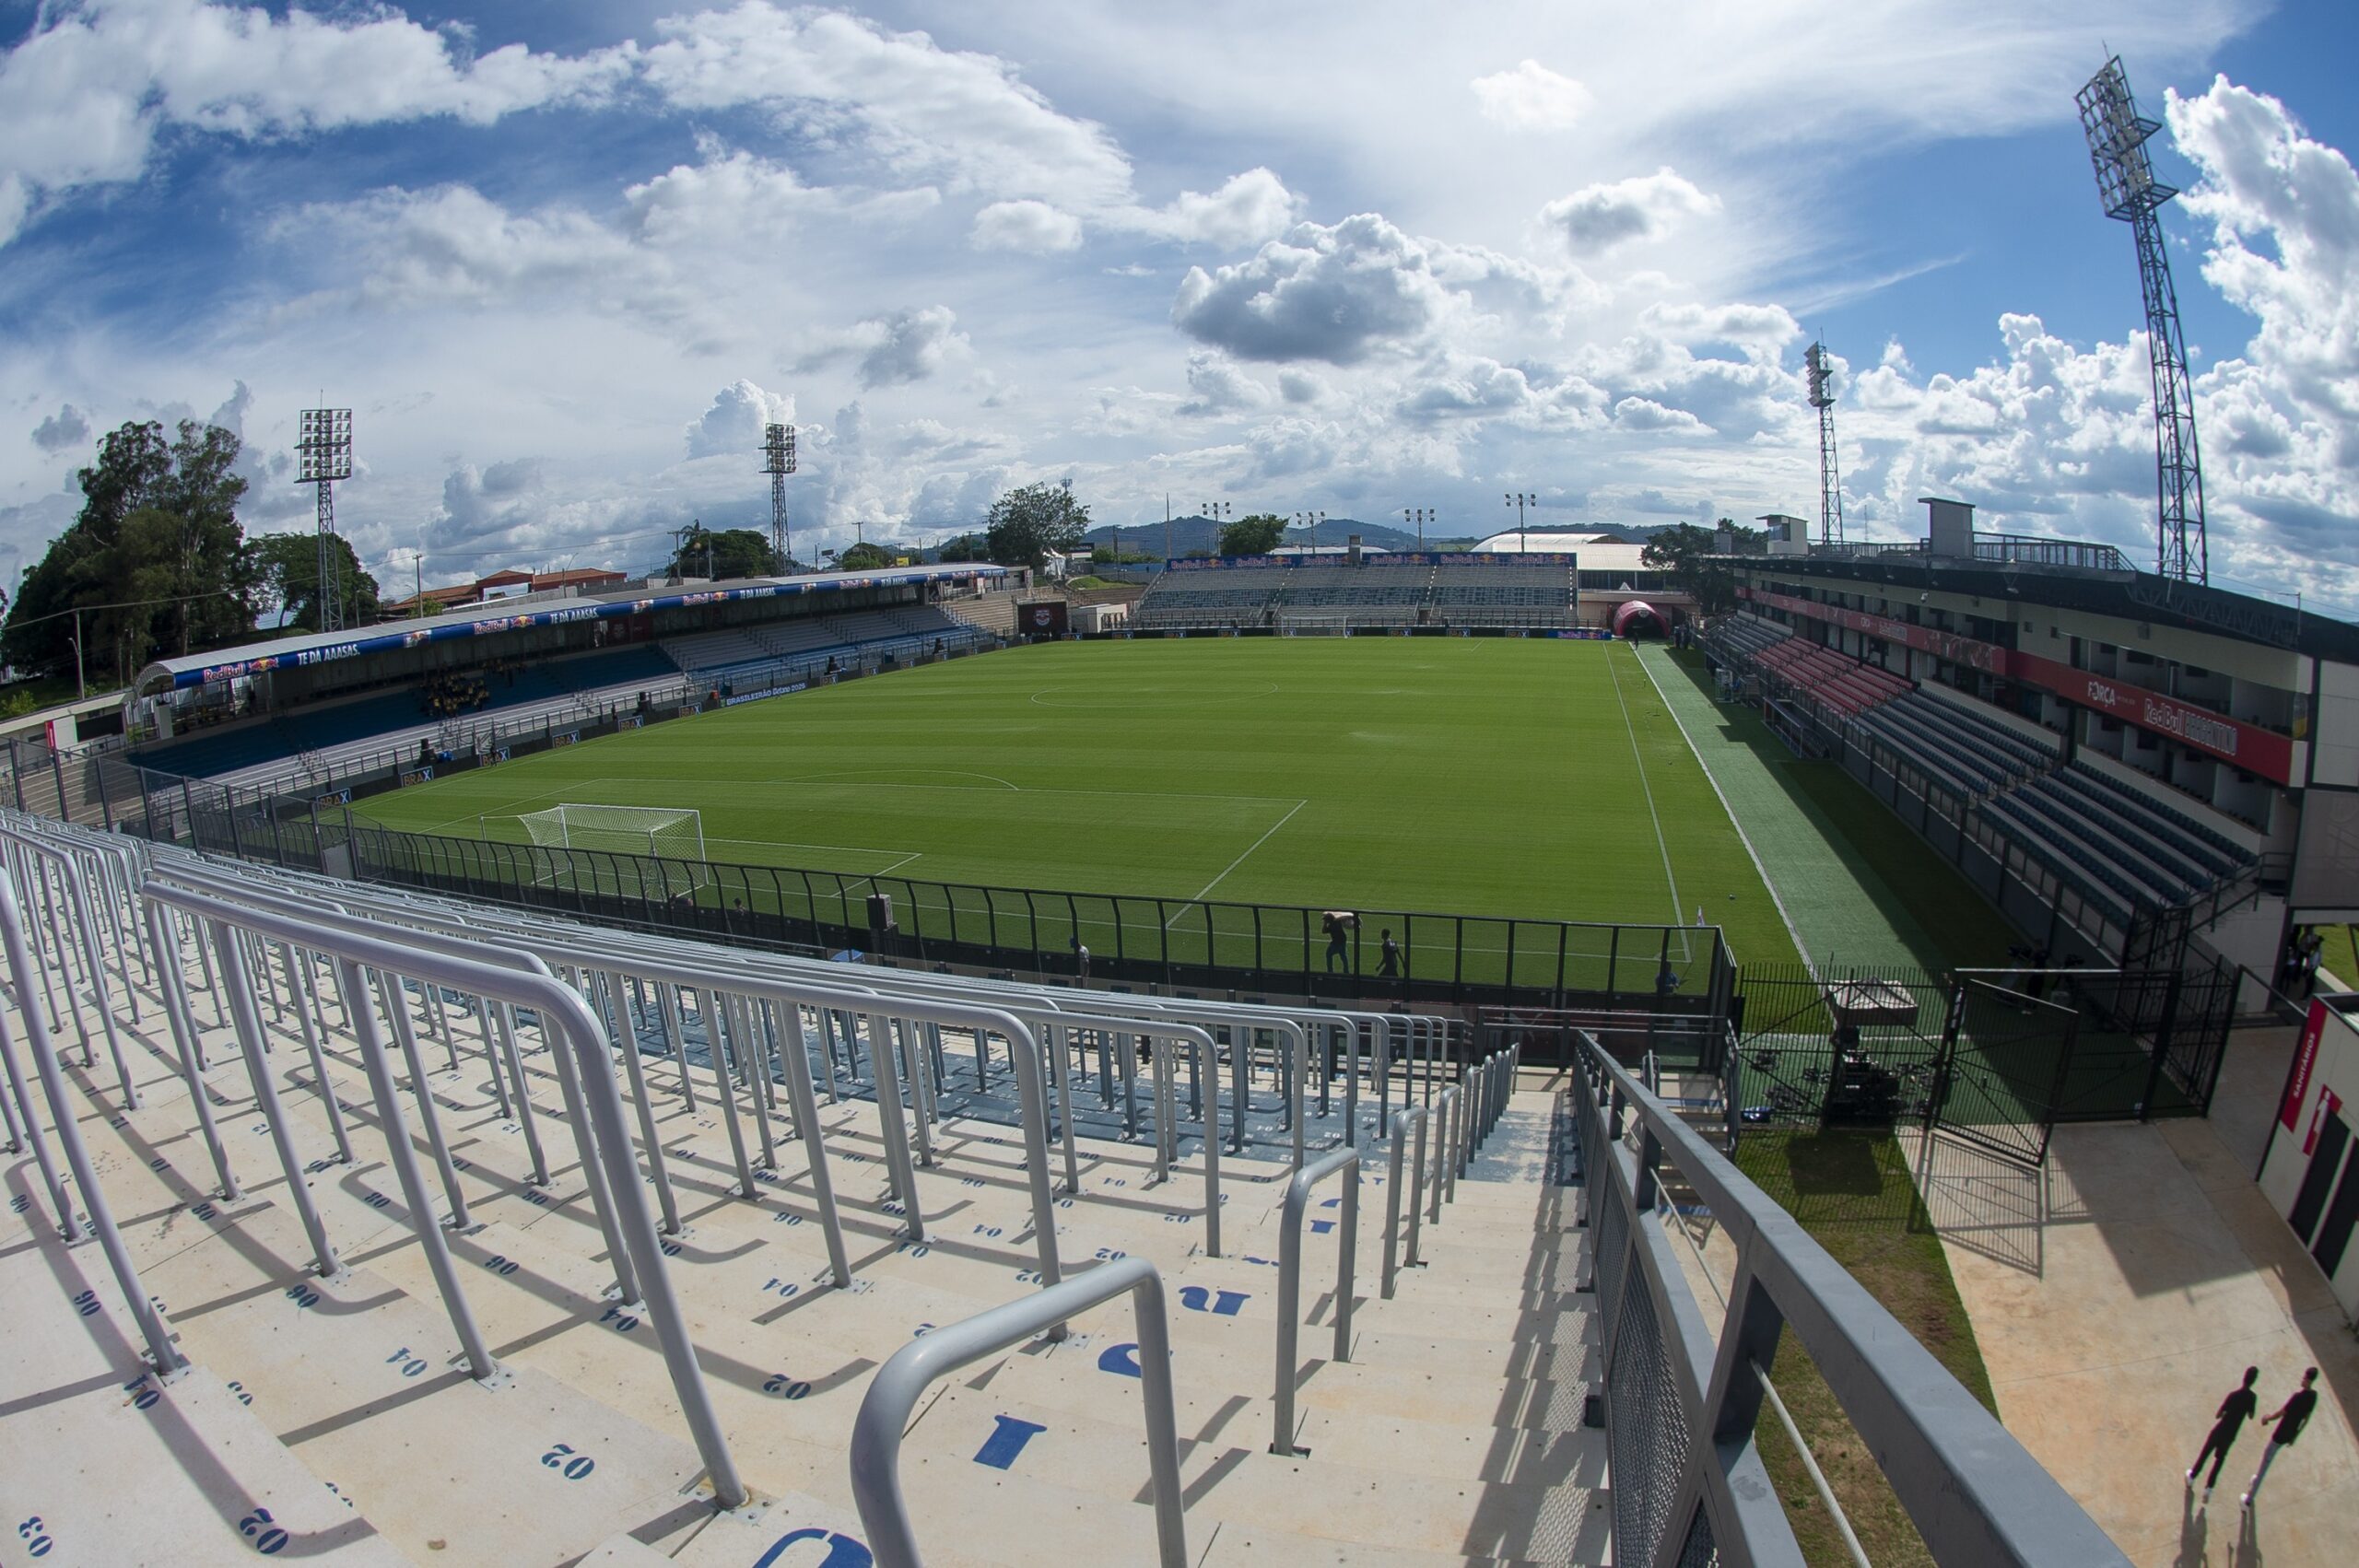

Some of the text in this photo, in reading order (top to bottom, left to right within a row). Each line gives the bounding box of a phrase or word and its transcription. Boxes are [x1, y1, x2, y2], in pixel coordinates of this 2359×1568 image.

[297, 652, 308, 666] TE
[2087, 680, 2116, 708] FORÇA
[404, 769, 431, 787] BRAX
[2292, 1031, 2317, 1100] SANITÁRIOS
[761, 1278, 800, 1297] 04
[386, 1347, 428, 1377] 04
[763, 1374, 812, 1399] 02
[542, 1444, 595, 1480] 02
[18, 1516, 53, 1557] 03
[240, 1507, 288, 1554] 02
